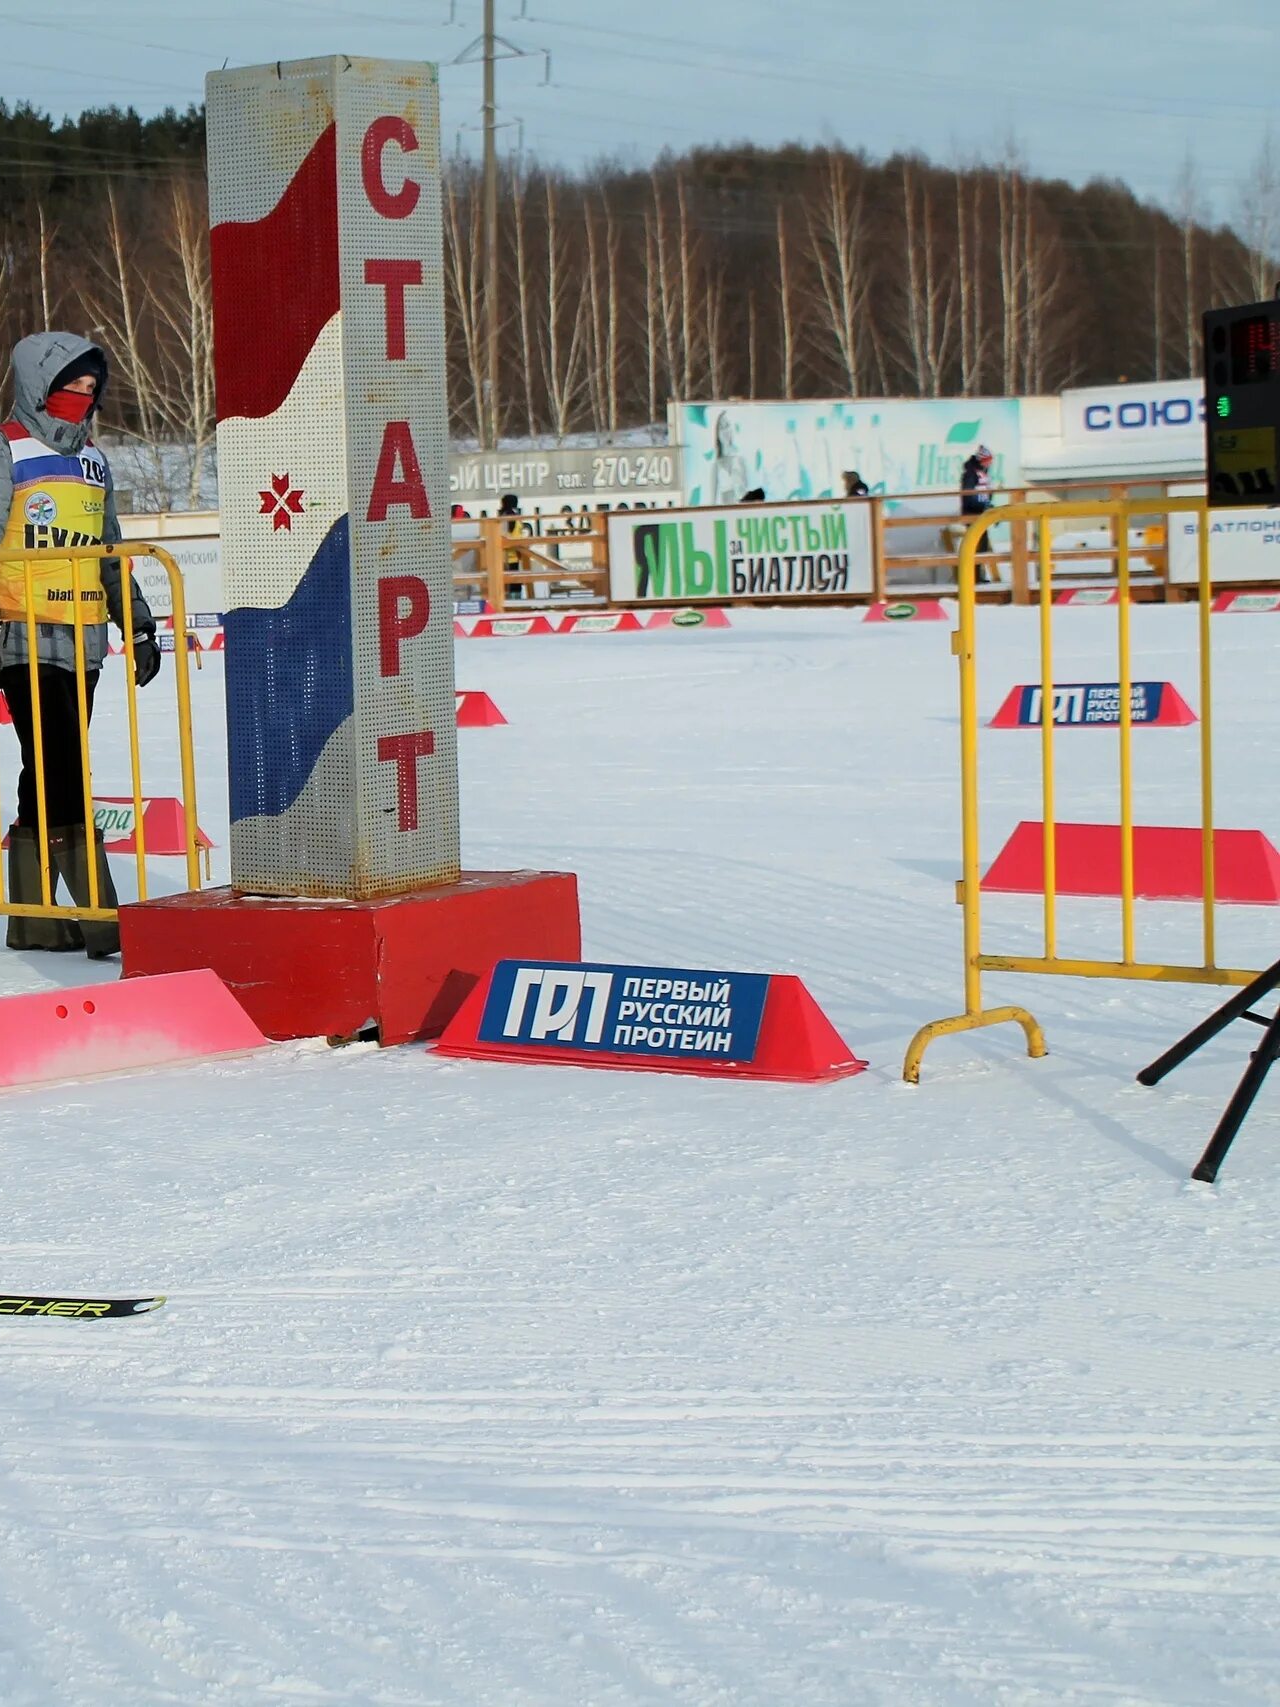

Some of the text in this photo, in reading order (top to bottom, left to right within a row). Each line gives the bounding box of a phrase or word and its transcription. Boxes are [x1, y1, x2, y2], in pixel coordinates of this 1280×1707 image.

[1084, 398, 1207, 432] СОЮ
[361, 114, 436, 832] СТАРТ
[484, 461, 551, 493] ЦЕНТР
[592, 456, 673, 488] 270-240
[736, 505, 848, 554] ЧИСТЫЙ
[622, 977, 731, 1003] ПЕРВЫЙ
[618, 1001, 732, 1027] РУССКИЙ
[613, 1025, 732, 1052] ПРОТЕИН
